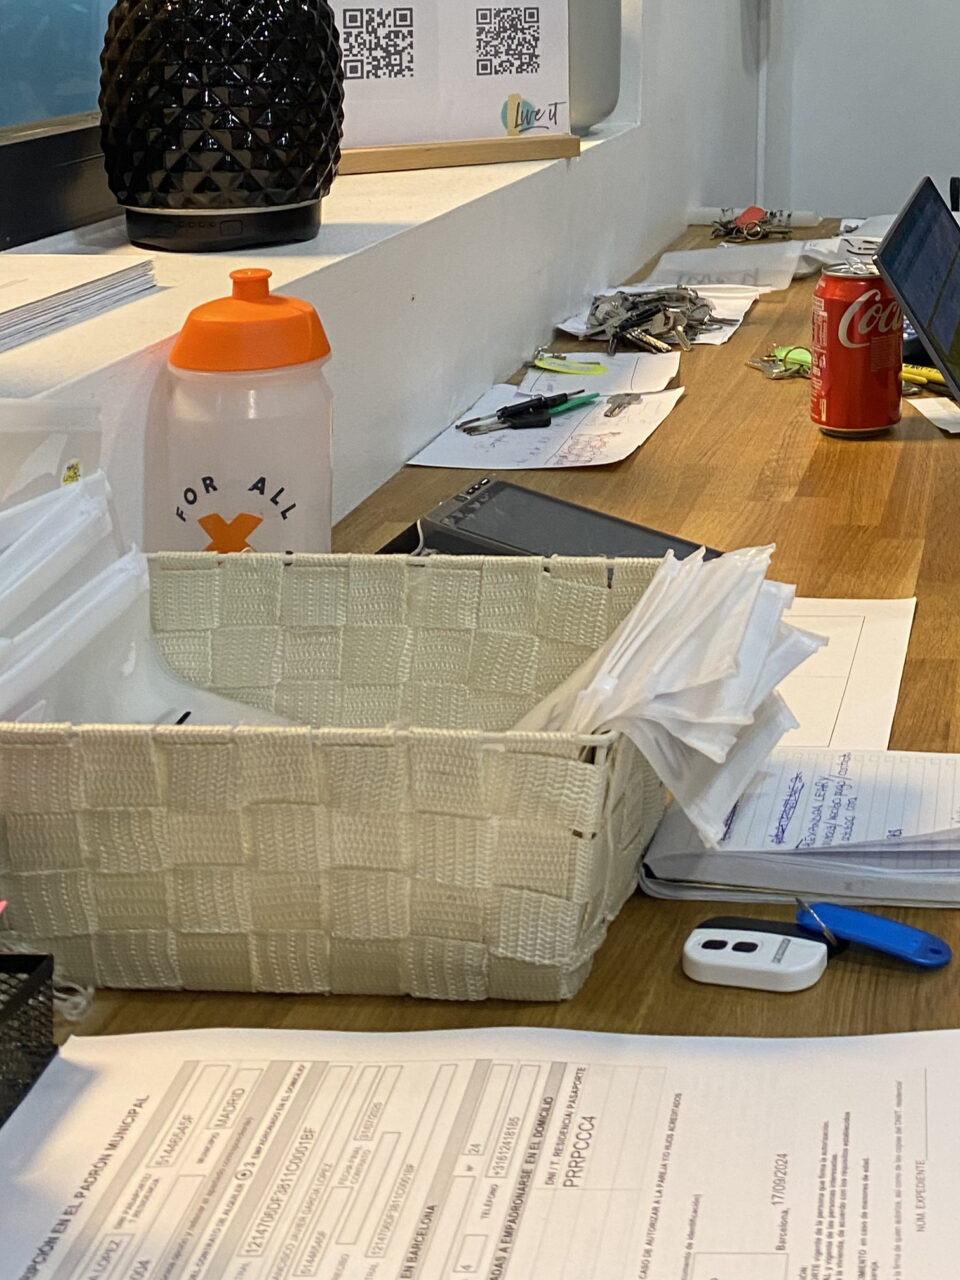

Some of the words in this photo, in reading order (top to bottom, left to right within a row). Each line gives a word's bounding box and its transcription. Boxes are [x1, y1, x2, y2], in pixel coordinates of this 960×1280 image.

[514, 100, 546, 127] Live
[548, 102, 567, 126] it
[176, 476, 218, 522] FOR
[248, 476, 296, 520] ALL
[214, 1087, 246, 1128] MADRID
[566, 1067, 586, 1109] PASAPORTE
[533, 1096, 554, 1138] DOMICILIO
[51, 1219, 71, 1233] EN
[63, 1202, 83, 1216] EL
[74, 1154, 112, 1198] PADRÓN
[104, 1095, 149, 1151] MUNICIPAL
[467, 1143, 482, 1154] 24
[524, 1152, 537, 1164] EN
[529, 1139, 541, 1150] EL
[563, 1115, 597, 1188] PRRPCCC4
[771, 1152, 789, 1206] 17/09/2024
[915, 1160, 926, 1209] EXPEDIENTE
[501, 1168, 533, 1244] EMPADRONARSE
[645, 1206, 661, 1246] AUTORIZAR
[657, 1163, 669, 1187] PAREJA
[405, 1204, 437, 1263] BARCELONA
[776, 1207, 790, 1251] Barcelona,
[401, 1265, 416, 1279] EN
